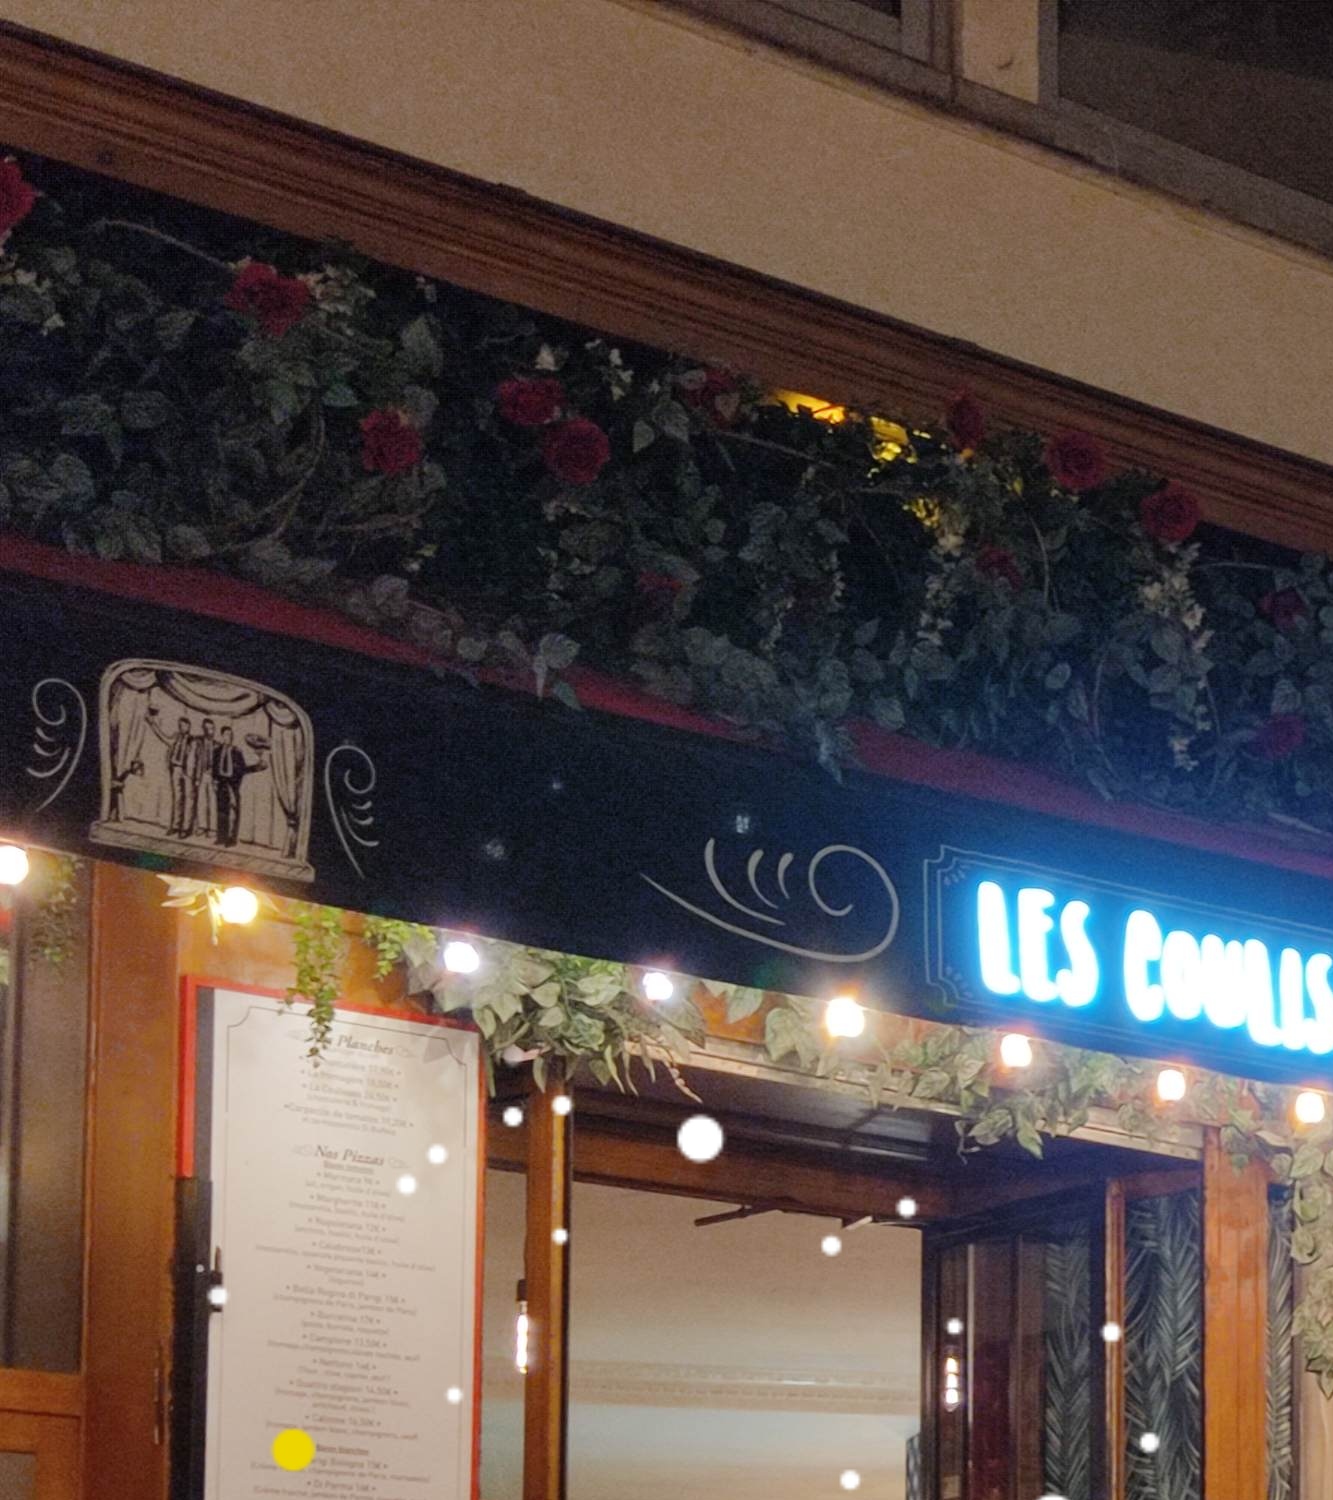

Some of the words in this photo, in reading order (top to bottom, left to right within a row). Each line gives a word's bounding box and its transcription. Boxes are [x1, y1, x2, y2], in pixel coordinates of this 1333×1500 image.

[977, 881, 1099, 1007] LES
[314, 1145, 338, 1160] Nos
[342, 1148, 384, 1166] Pizzas
